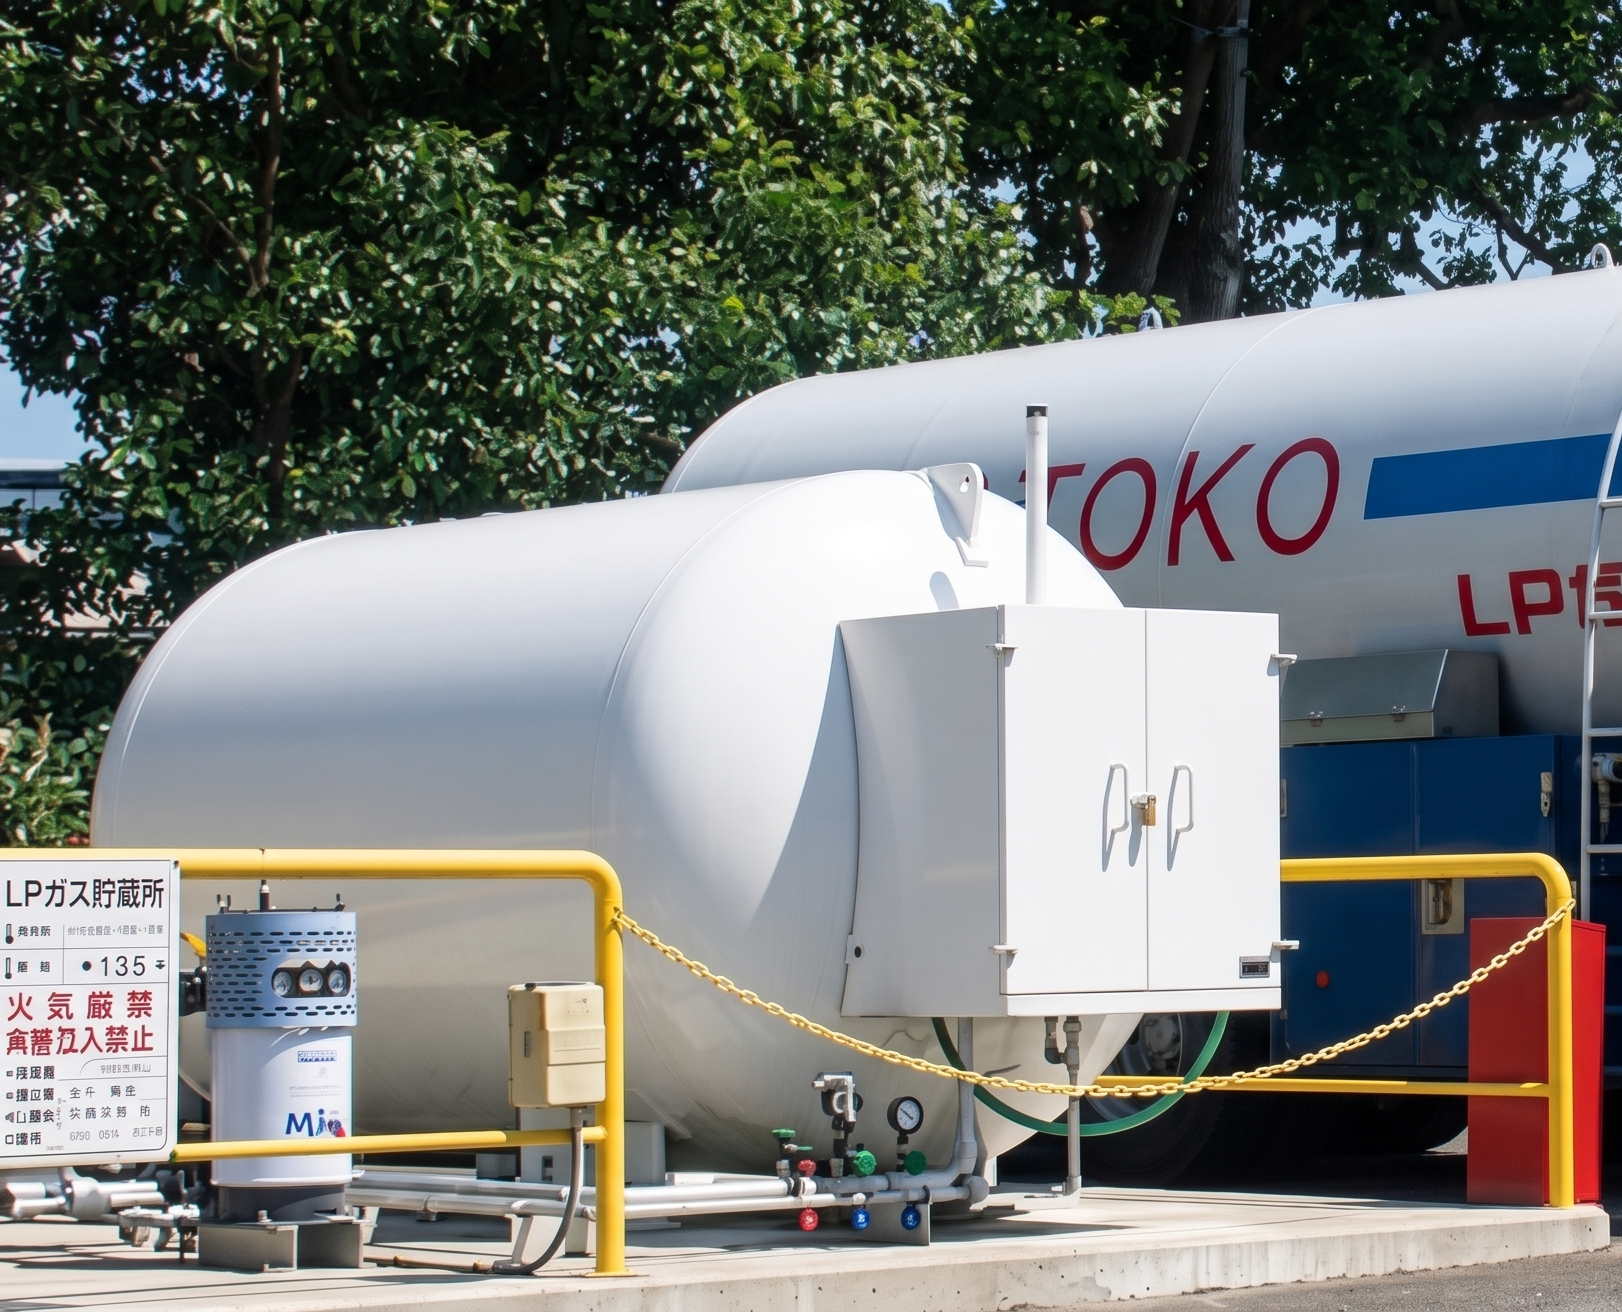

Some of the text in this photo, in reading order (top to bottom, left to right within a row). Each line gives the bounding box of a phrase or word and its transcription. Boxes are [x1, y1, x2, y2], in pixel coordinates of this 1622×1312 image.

[6, 878, 164, 909] LPガス貯蔵所
[100, 955, 146, 977] 135
[7, 990, 153, 1022] 火気厳禁
